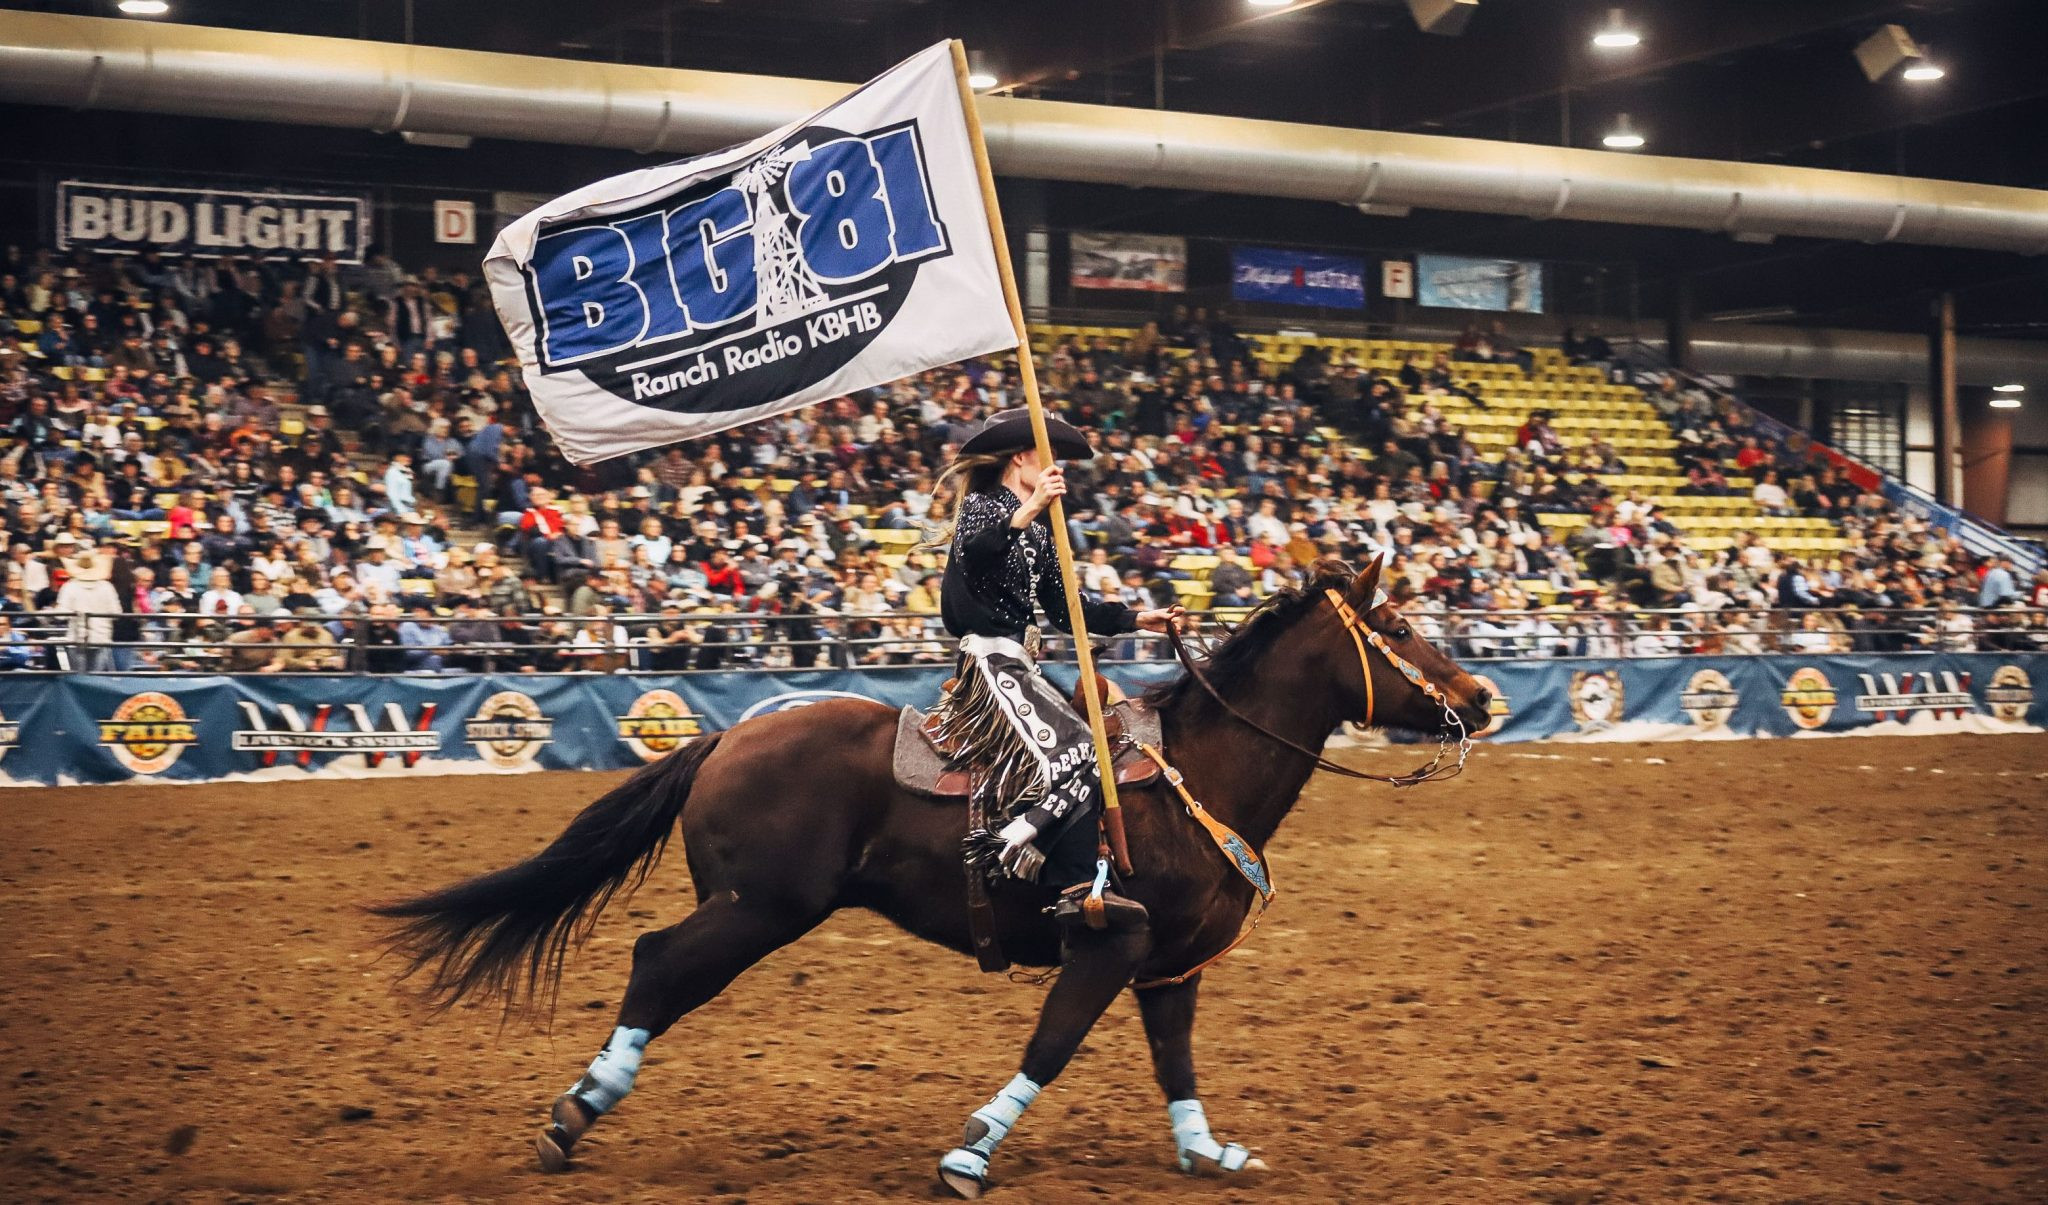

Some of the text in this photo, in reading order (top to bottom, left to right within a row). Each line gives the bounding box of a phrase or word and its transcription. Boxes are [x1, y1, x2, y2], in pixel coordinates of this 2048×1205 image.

[69, 195, 353, 252] BUD LIGHT
[442, 208, 466, 238] D
[528, 124, 950, 366] BIG 81
[1390, 267, 1404, 288] F
[630, 302, 883, 400] Ranch Radio KBHB
[99, 724, 198, 742] FAIR
[619, 718, 702, 737] FAIR
